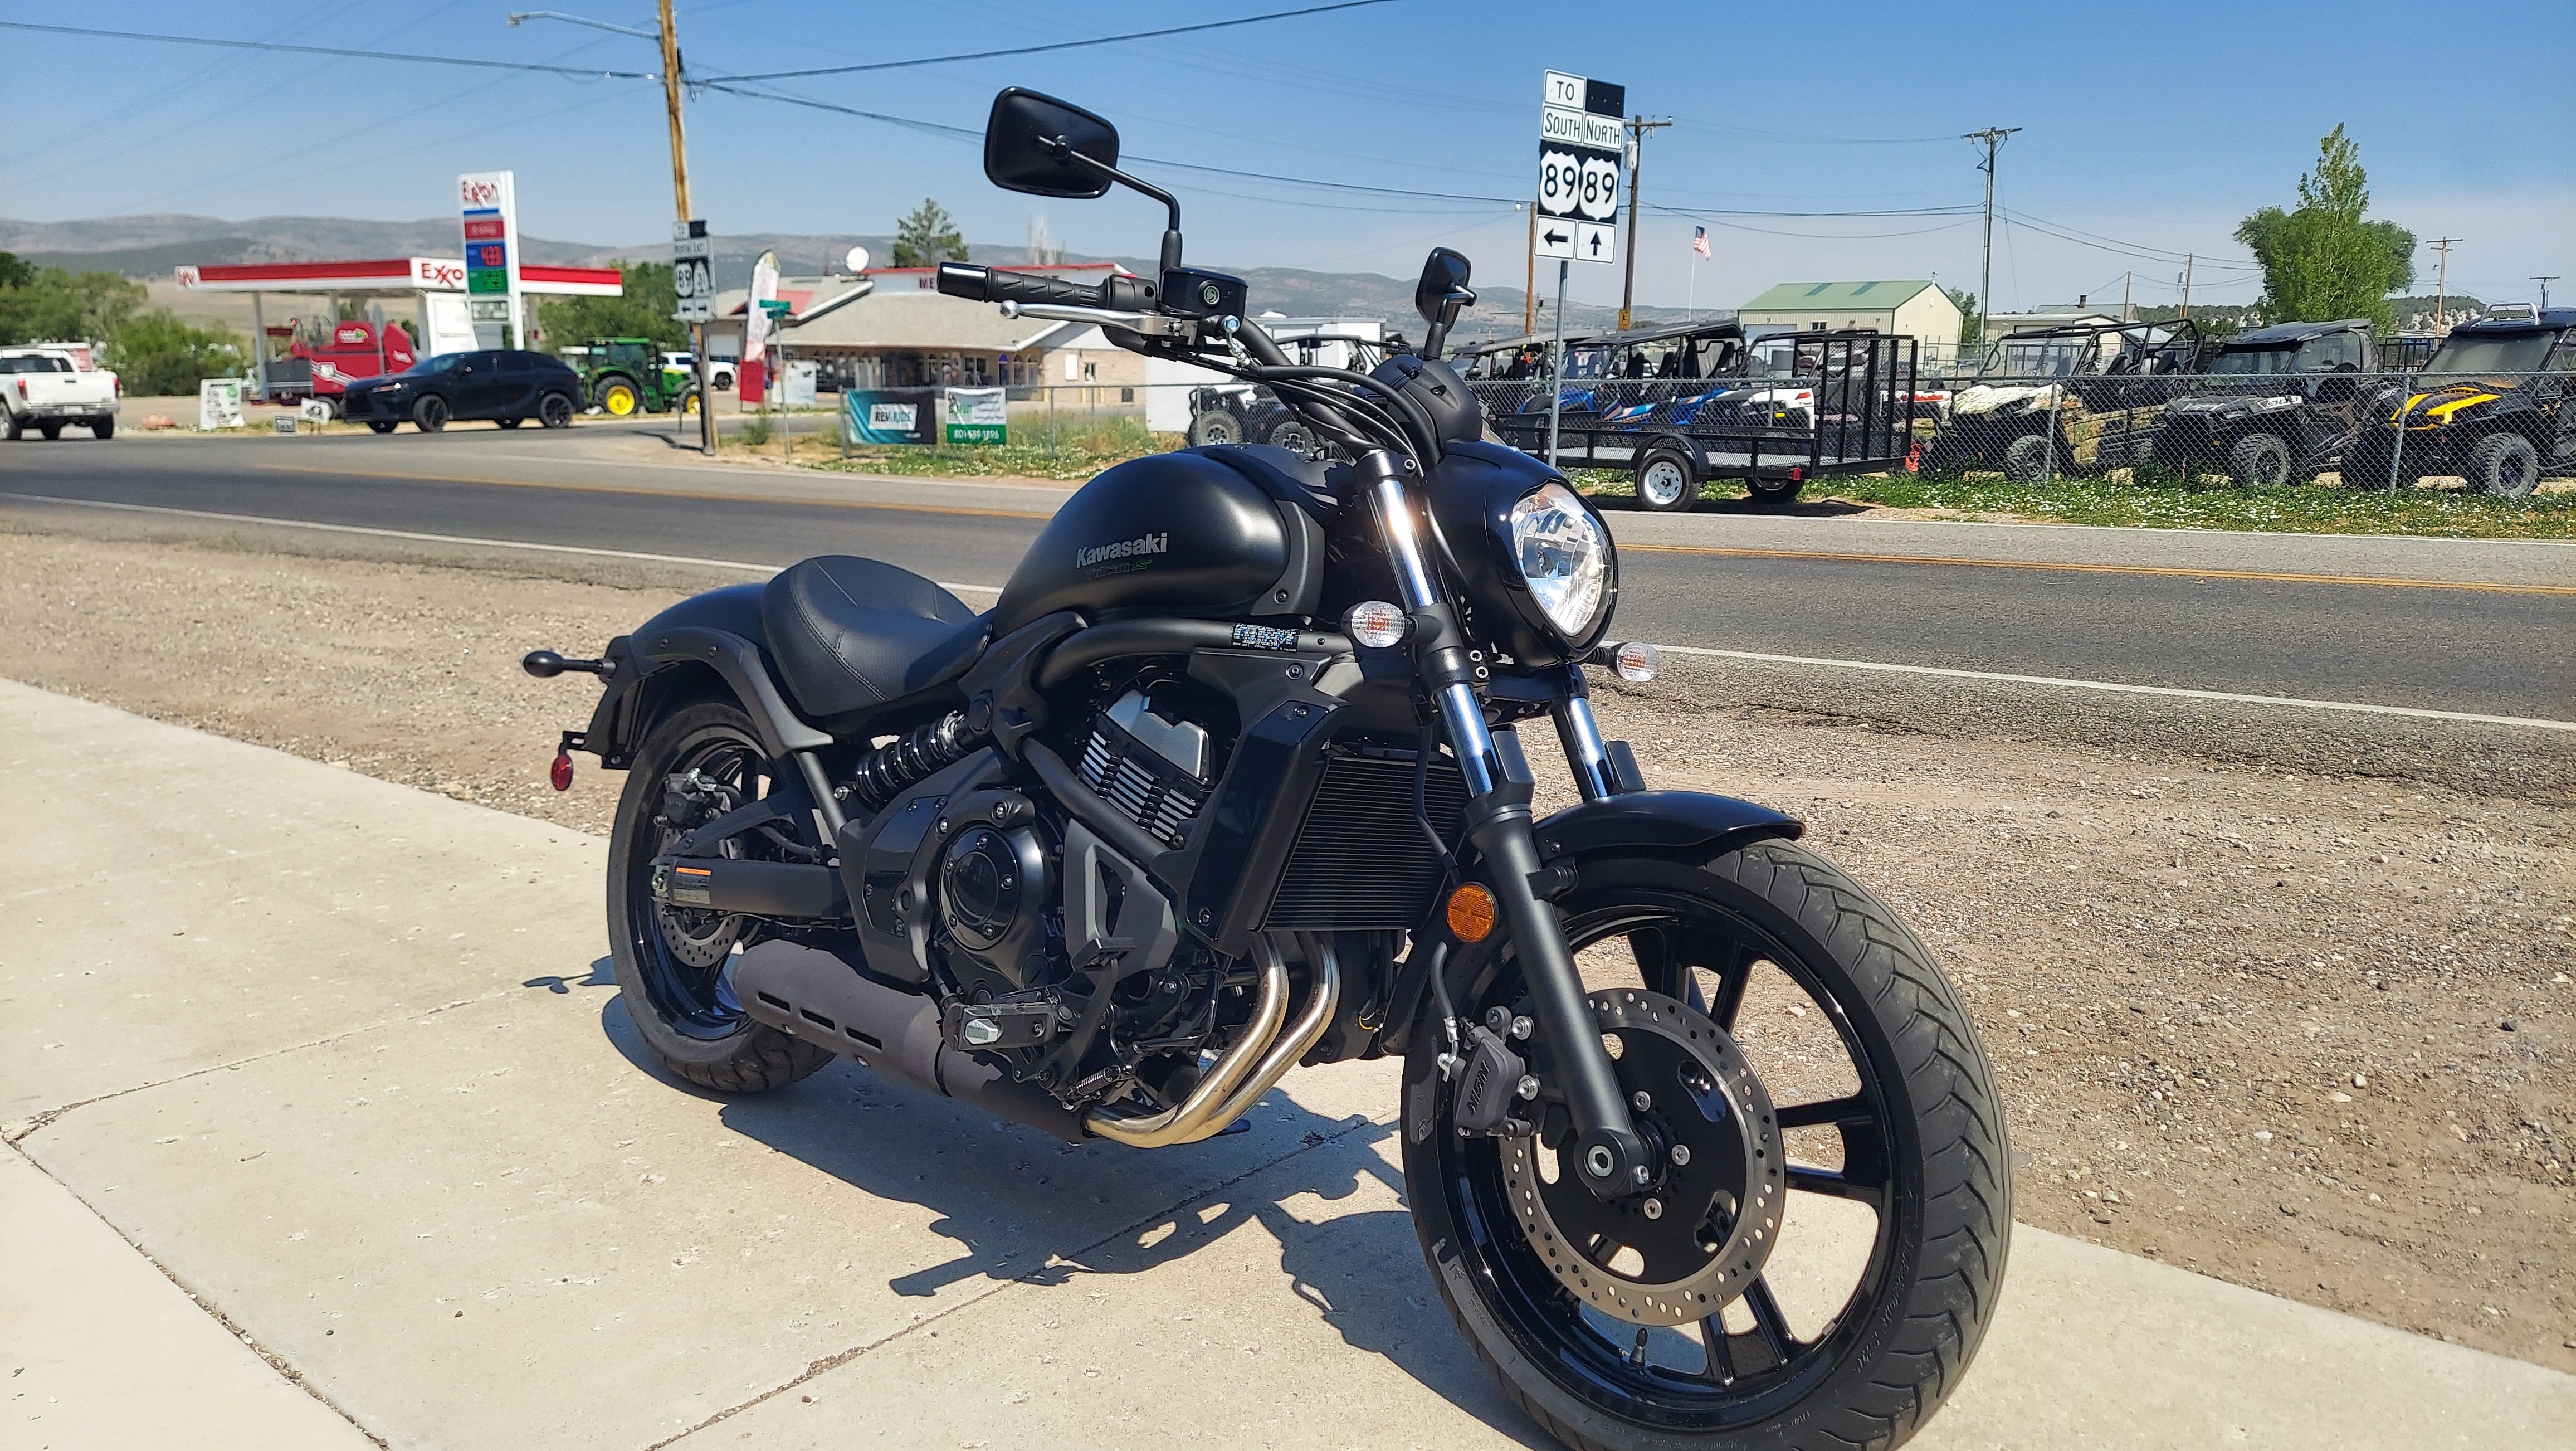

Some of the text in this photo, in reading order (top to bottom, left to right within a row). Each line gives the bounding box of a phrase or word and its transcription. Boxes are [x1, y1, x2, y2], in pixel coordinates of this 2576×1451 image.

[1557, 81, 1574, 100] TO
[1545, 112, 1580, 138] SOUTH
[1585, 119, 1621, 145] NORTH
[1544, 163, 1576, 199] 89
[1584, 171, 1615, 204] 89
[421, 263, 464, 288] Exxo
[919, 278, 935, 289] ME
[1076, 532, 1168, 568] Kawasaki
